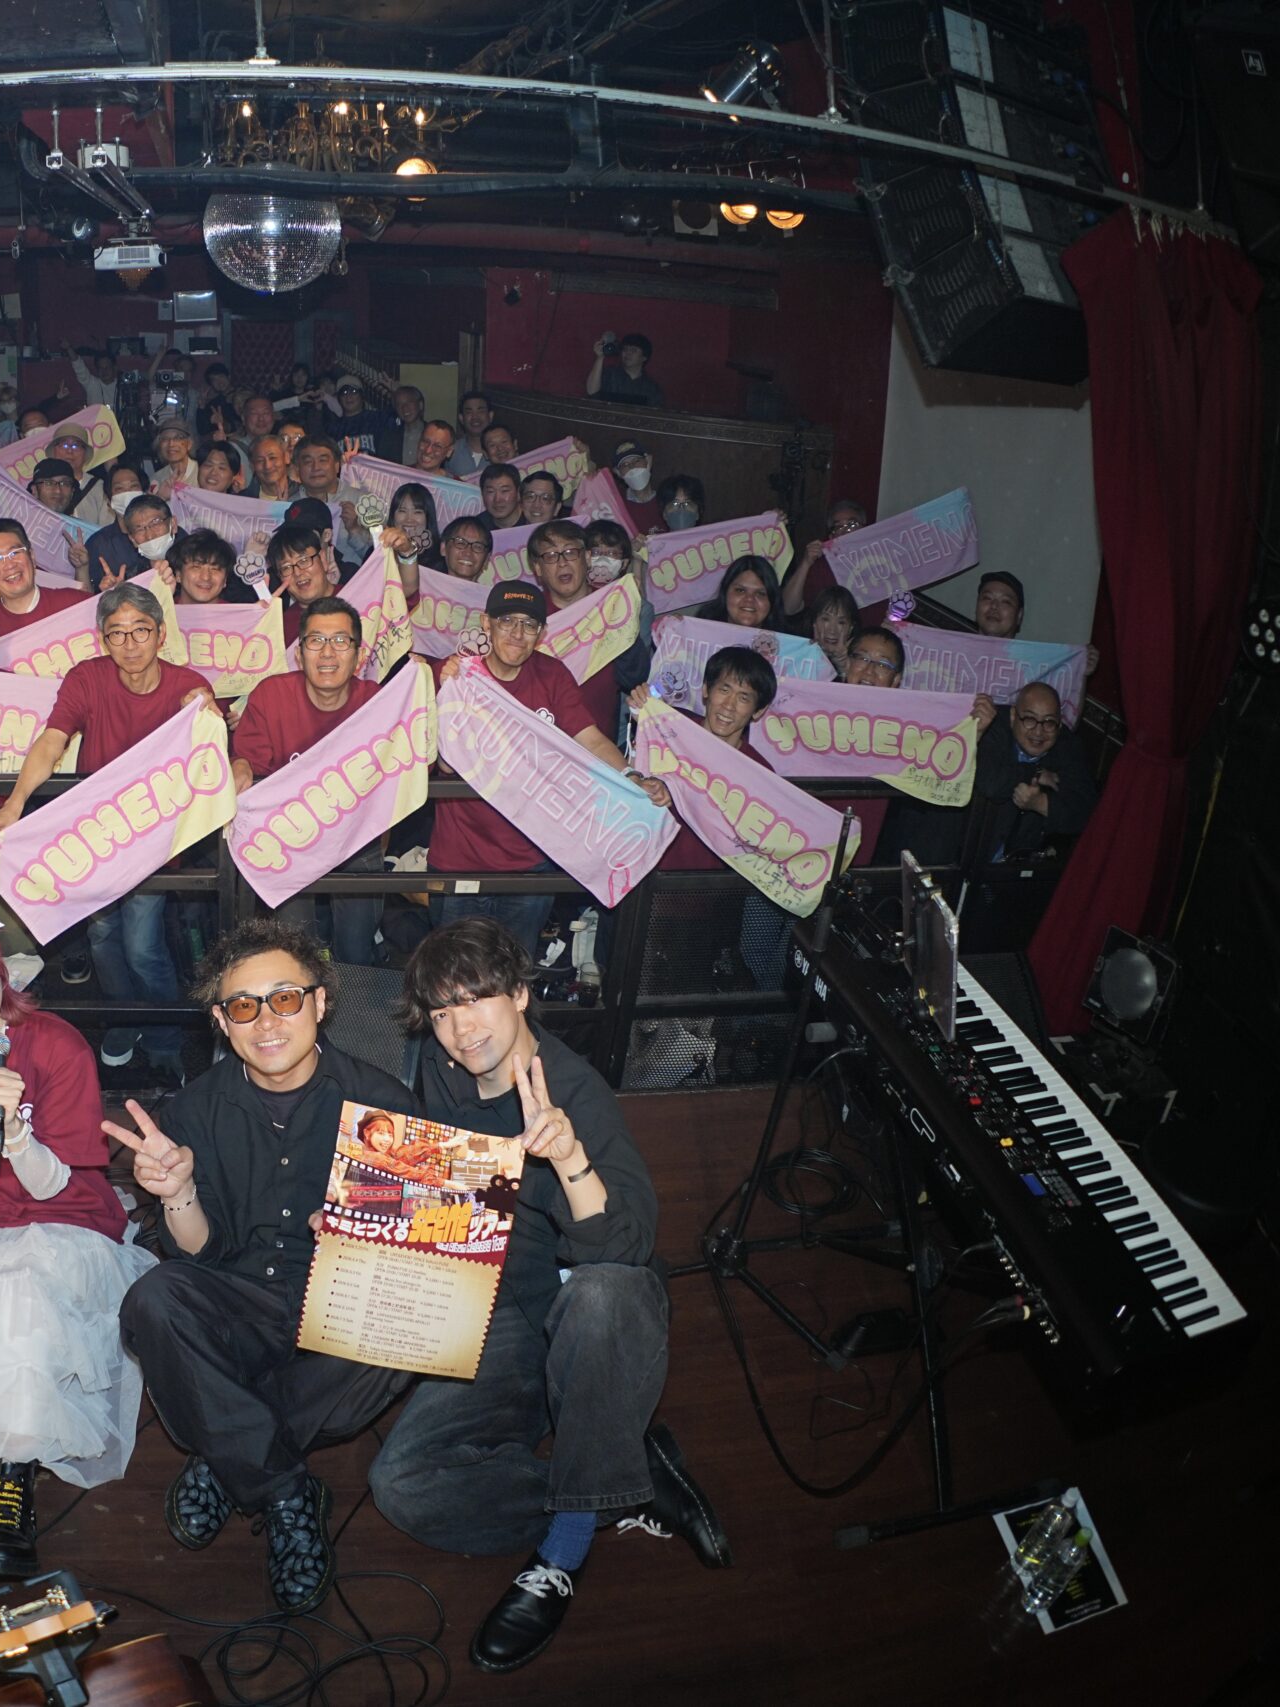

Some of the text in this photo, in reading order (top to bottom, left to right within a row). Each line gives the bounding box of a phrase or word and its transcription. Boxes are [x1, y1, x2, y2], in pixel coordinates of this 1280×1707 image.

[14, 740, 230, 906] YUMENO
[451, 684, 651, 870] YUMENO
[649, 740, 832, 890] YUMENO
[762, 709, 968, 781] YUMENO
